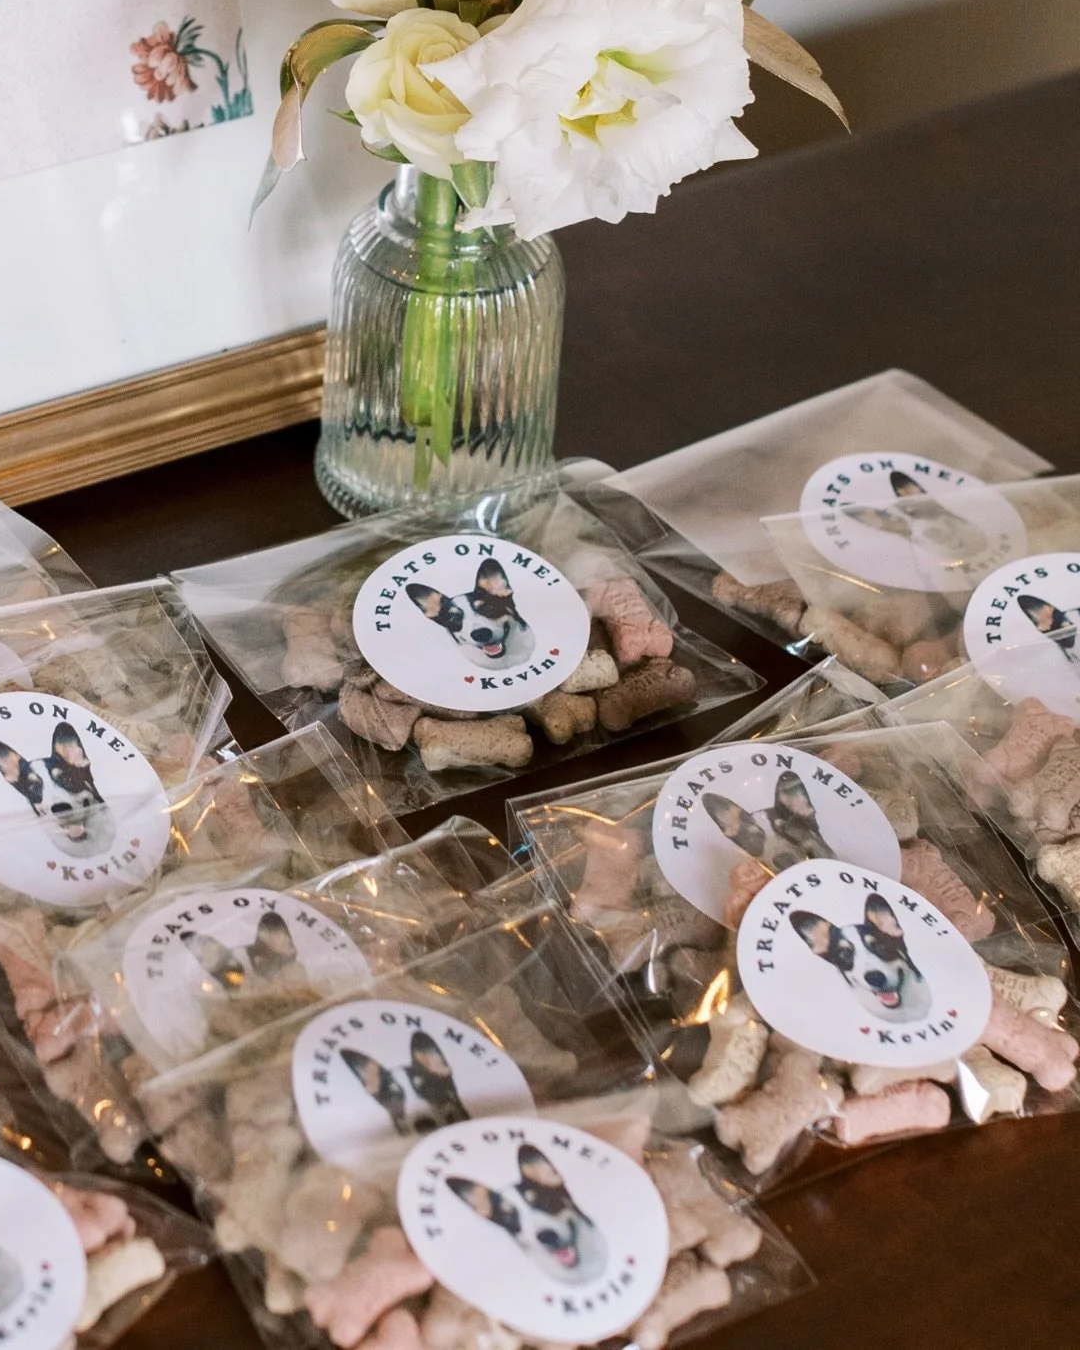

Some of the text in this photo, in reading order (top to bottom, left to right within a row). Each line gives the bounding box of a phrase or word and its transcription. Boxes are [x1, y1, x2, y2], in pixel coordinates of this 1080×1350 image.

[859, 459, 896, 474] ON
[374, 543, 561, 632] TREATS ON ME!
[985, 566, 1049, 644] TREATS
[479, 657, 557, 690] Kevin
[28, 701, 70, 721] ON
[85, 719, 136, 762] ME!
[671, 752, 864, 851] TREATS ON ME!
[60, 848, 138, 882] Kevin
[232, 896, 277, 912] ON
[295, 910, 347, 951] ME!
[756, 873, 822, 974] TREATS
[838, 871, 880, 893] ON
[898, 894, 950, 937] ME!
[313, 1011, 500, 1106] TREATS ON ME!
[876, 1019, 955, 1045] Kevin
